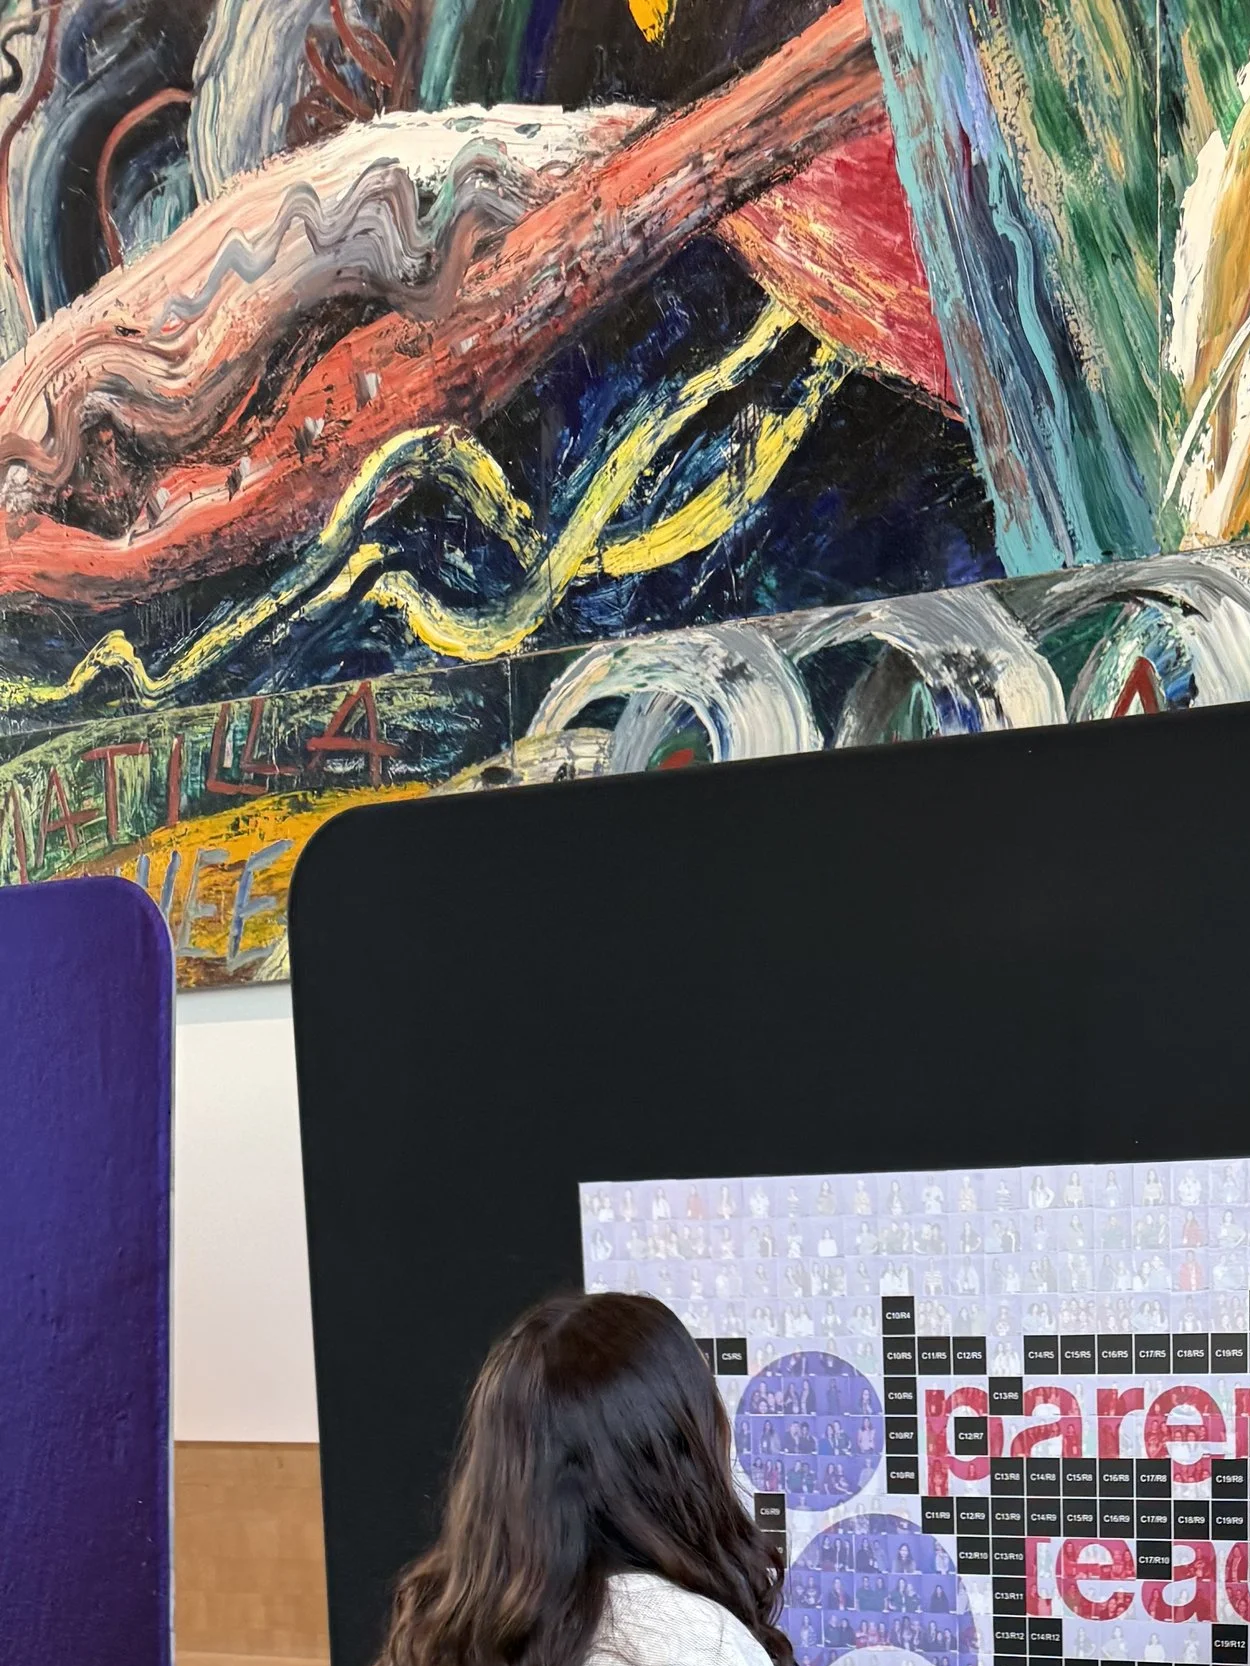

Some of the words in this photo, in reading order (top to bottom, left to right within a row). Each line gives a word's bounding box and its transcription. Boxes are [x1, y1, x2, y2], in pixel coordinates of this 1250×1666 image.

[885, 1311, 911, 1320] C10/R4
[886, 1351, 913, 1360] C10/R5
[921, 1351, 948, 1360] C11/R5
[956, 1351, 983, 1360] C12/R5
[1027, 1350, 1055, 1359] C14/R5
[1064, 1350, 1092, 1359] C15/R5
[1101, 1350, 1129, 1359] C16/R5
[1138, 1349, 1167, 1358] C17/R5
[1176, 1349, 1205, 1358] C18/R5
[1214, 1348, 1244, 1358] C19/R5
[887, 1391, 914, 1400] C10/R6
[992, 1391, 1019, 1400] C13/R6
[888, 1431, 915, 1440] C10/R7
[958, 1432, 984, 1441] C12/R7
[889, 1470, 915, 1480] C10/R8
[994, 1472, 1021, 1481] C13/R8
[1029, 1472, 1057, 1482] C14/R8
[1065, 1473, 1093, 1482] C15/R8
[1102, 1473, 1130, 1482] C16/R8
[1139, 1474, 1168, 1483] C17/R8
[1215, 1474, 1244, 1484] C19/R8
[924, 1511, 951, 1520] C11/R9
[959, 1511, 986, 1520] C12/R9
[994, 1512, 1022, 1521] C13/R9
[1030, 1513, 1058, 1522] C14/R9
[1066, 1513, 1094, 1523] C15/R9
[1103, 1514, 1131, 1523] C16/R9
[1140, 1515, 1168, 1524] C17/R9
[1177, 1515, 1206, 1524] C18/R9
[1215, 1516, 1244, 1525] C19/R9
[958, 1551, 989, 1560] C12/R10
[993, 1552, 1024, 1561] C13/R10
[1138, 1555, 1170, 1565] C17/R10
[994, 1591, 1024, 1600] C13/R11
[994, 1631, 1025, 1641] C13/R12
[1030, 1632, 1061, 1642] C14/R12
[1213, 1639, 1246, 1649] C19/R12
